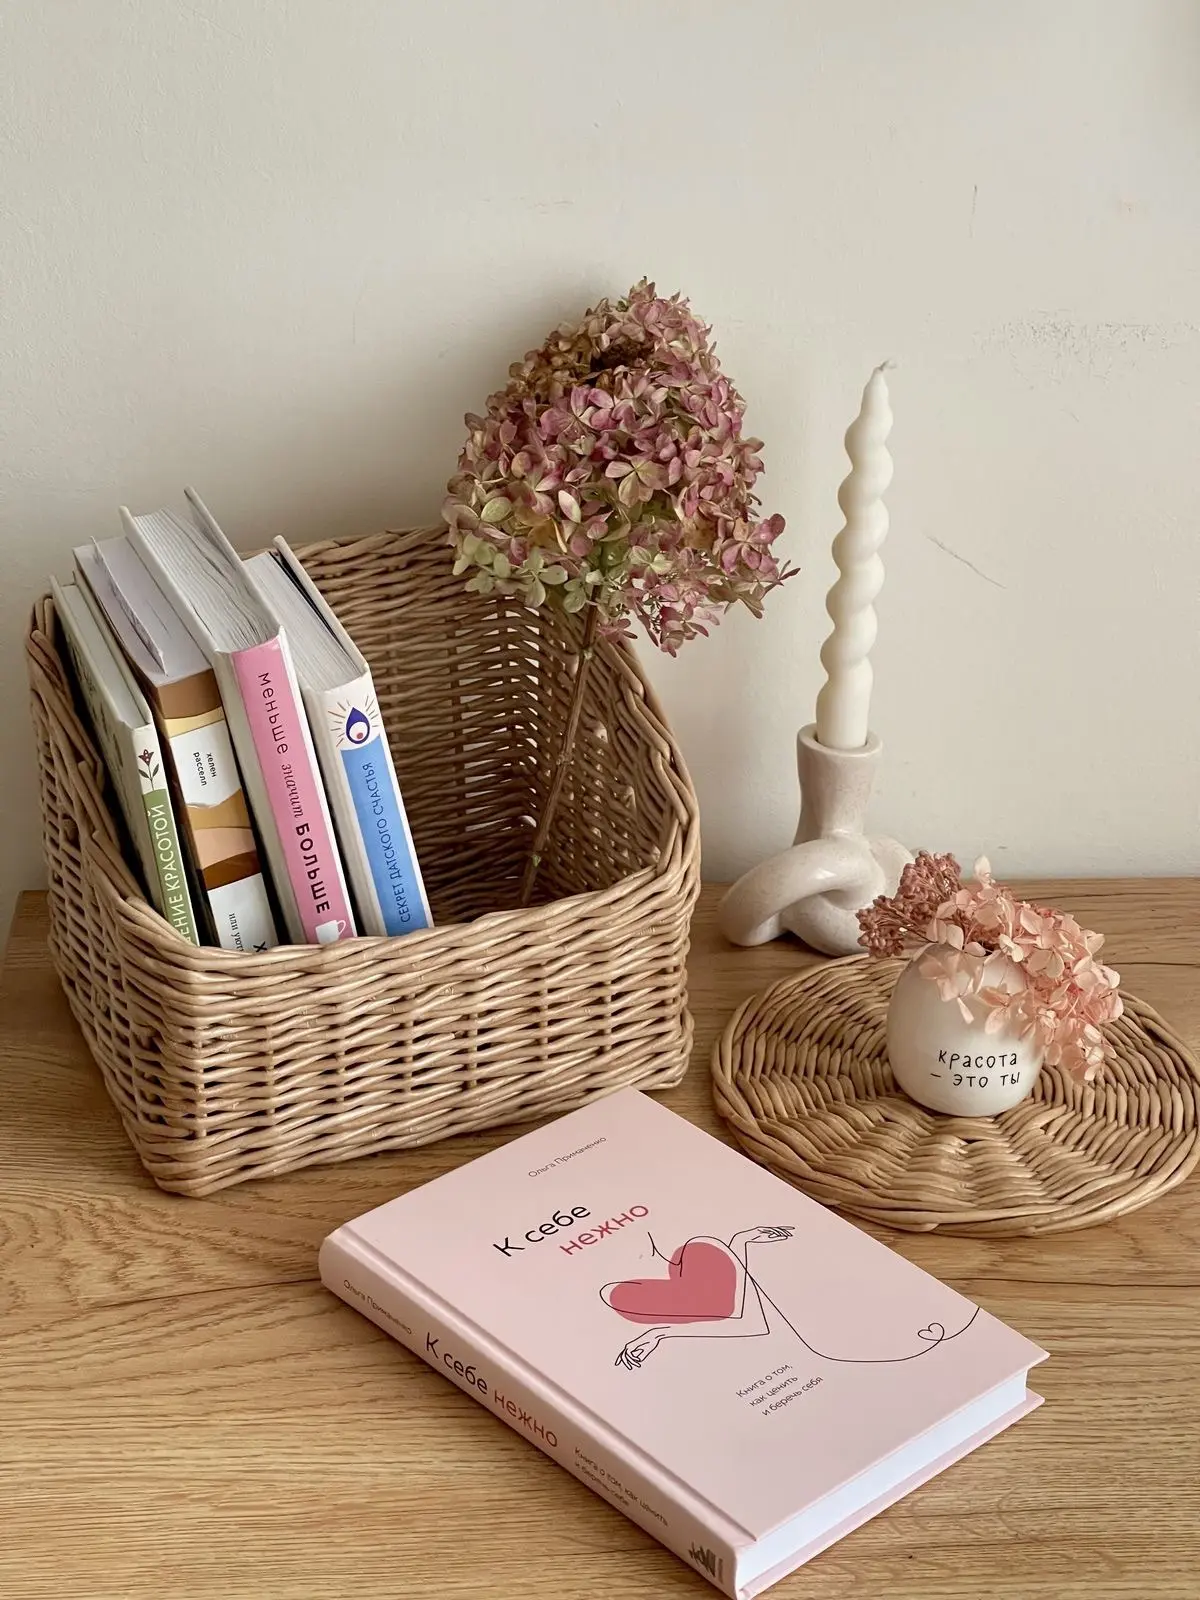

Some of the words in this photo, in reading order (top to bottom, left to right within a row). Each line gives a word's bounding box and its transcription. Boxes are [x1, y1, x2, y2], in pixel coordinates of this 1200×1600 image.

[193, 751, 208, 787] расселл
[206, 752, 217, 778] хелен
[362, 762, 384, 816] СЧАСТЬЯ
[147, 804, 179, 892] КРАСОТОЙ
[281, 763, 304, 818] значит
[295, 822, 331, 914] БОЛЬШЕ
[376, 818, 402, 881] ДАТСКОГО
[229, 913, 240, 931] или
[392, 882, 411, 923] СЕКРЕТ
[231, 932, 245, 952] уют
[528, 1161, 556, 1178] Ольга
[554, 1137, 607, 1165] Примаченко
[492, 1236, 526, 1257] К
[525, 1205, 591, 1243] себе
[559, 1205, 649, 1256] нежно
[425, 1331, 440, 1359] К
[443, 1352, 488, 1395] себе
[493, 1389, 558, 1448] нежно
[735, 1379, 766, 1398] Книга
[771, 1364, 793, 1377] том,
[749, 1395, 768, 1407] как
[766, 1376, 798, 1397] ценить
[768, 1390, 803, 1411] беречь
[801, 1376, 824, 1392] себя
